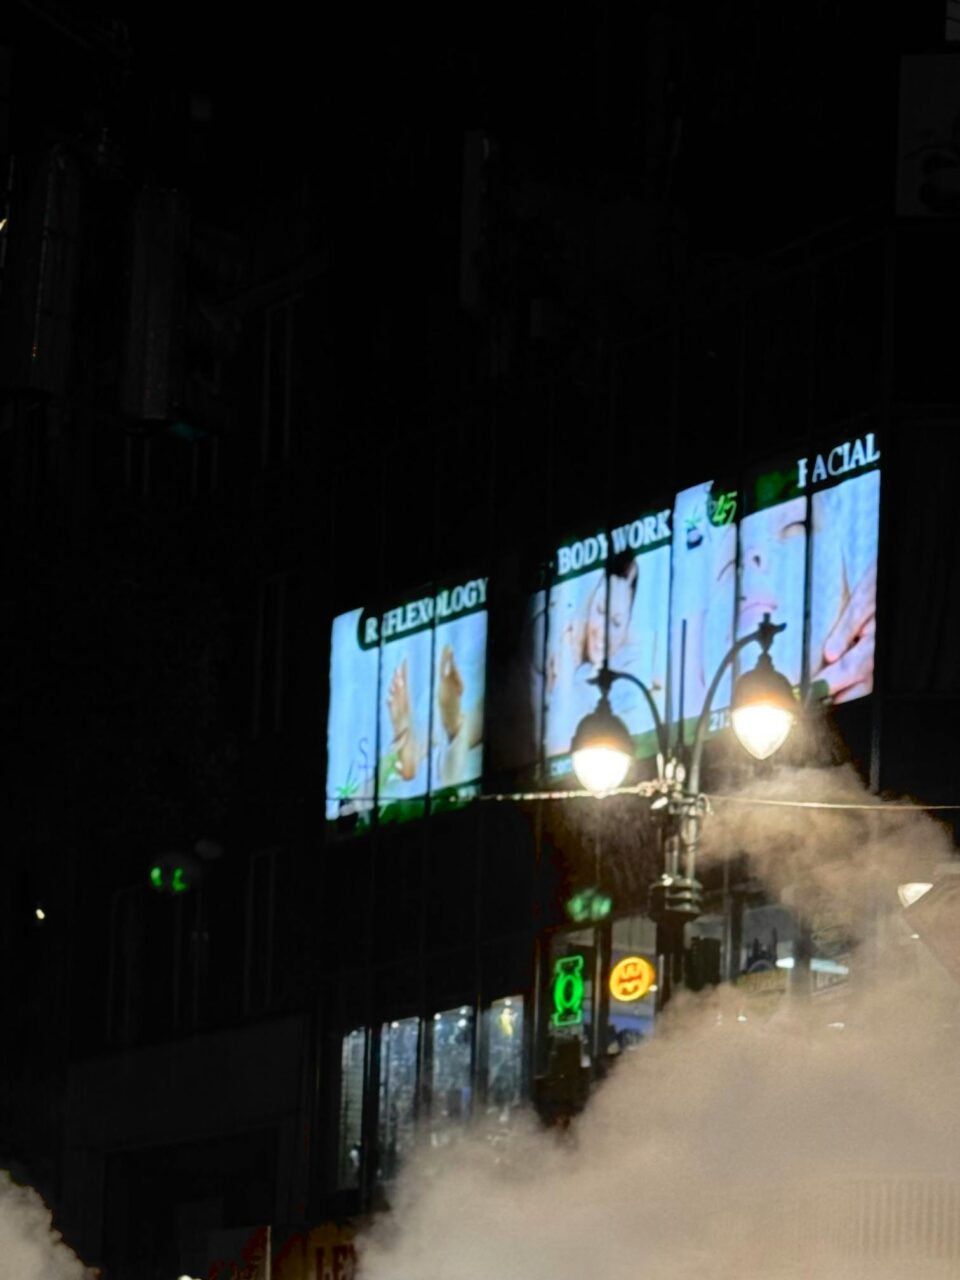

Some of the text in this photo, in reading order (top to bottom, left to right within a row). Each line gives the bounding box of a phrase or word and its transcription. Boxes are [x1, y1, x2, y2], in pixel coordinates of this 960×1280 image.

[797, 432, 881, 489] FACIAL
[557, 508, 671, 576] BODY WORK
